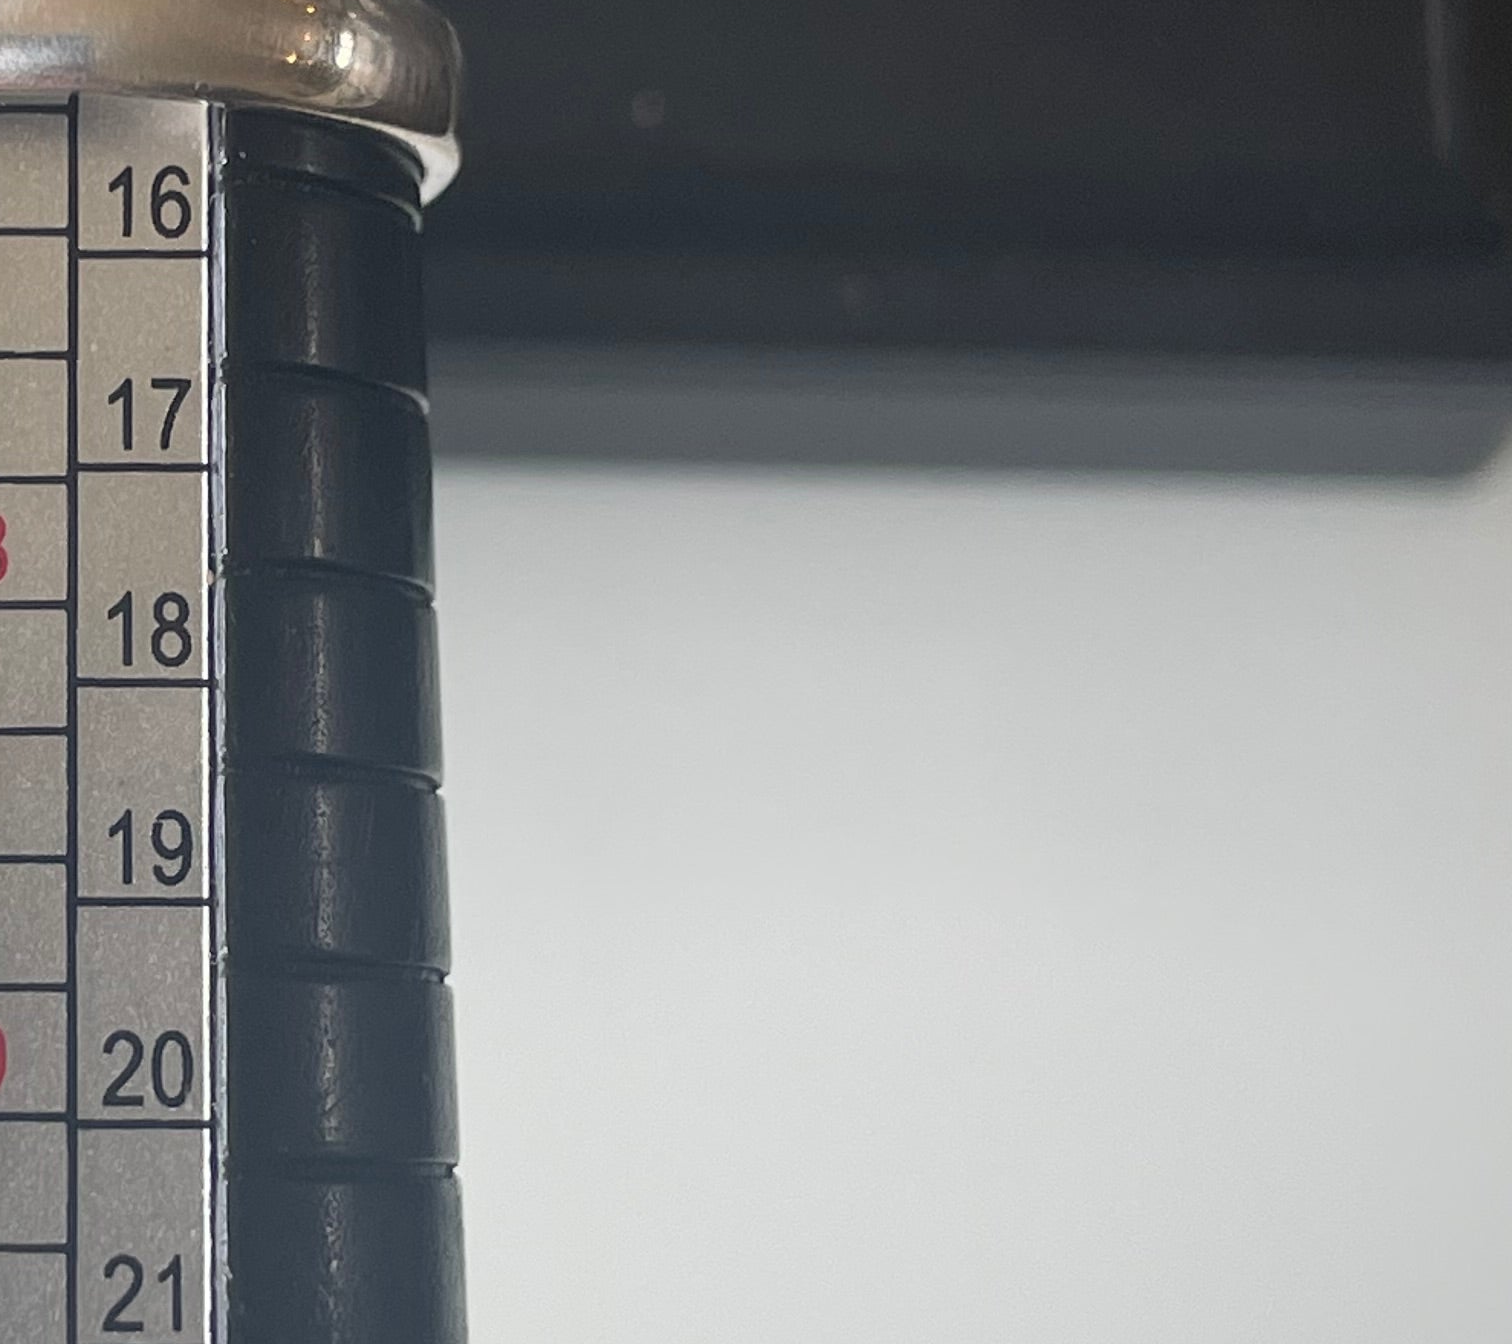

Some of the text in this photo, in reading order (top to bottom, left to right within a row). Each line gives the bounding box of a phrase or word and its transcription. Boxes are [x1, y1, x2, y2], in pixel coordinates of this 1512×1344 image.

[107, 164, 193, 241] 16
[106, 376, 193, 453] 17
[106, 590, 194, 669] 18
[107, 808, 195, 888] 19
[100, 1029, 195, 1110] 20
[100, 1252, 184, 1334] 21
